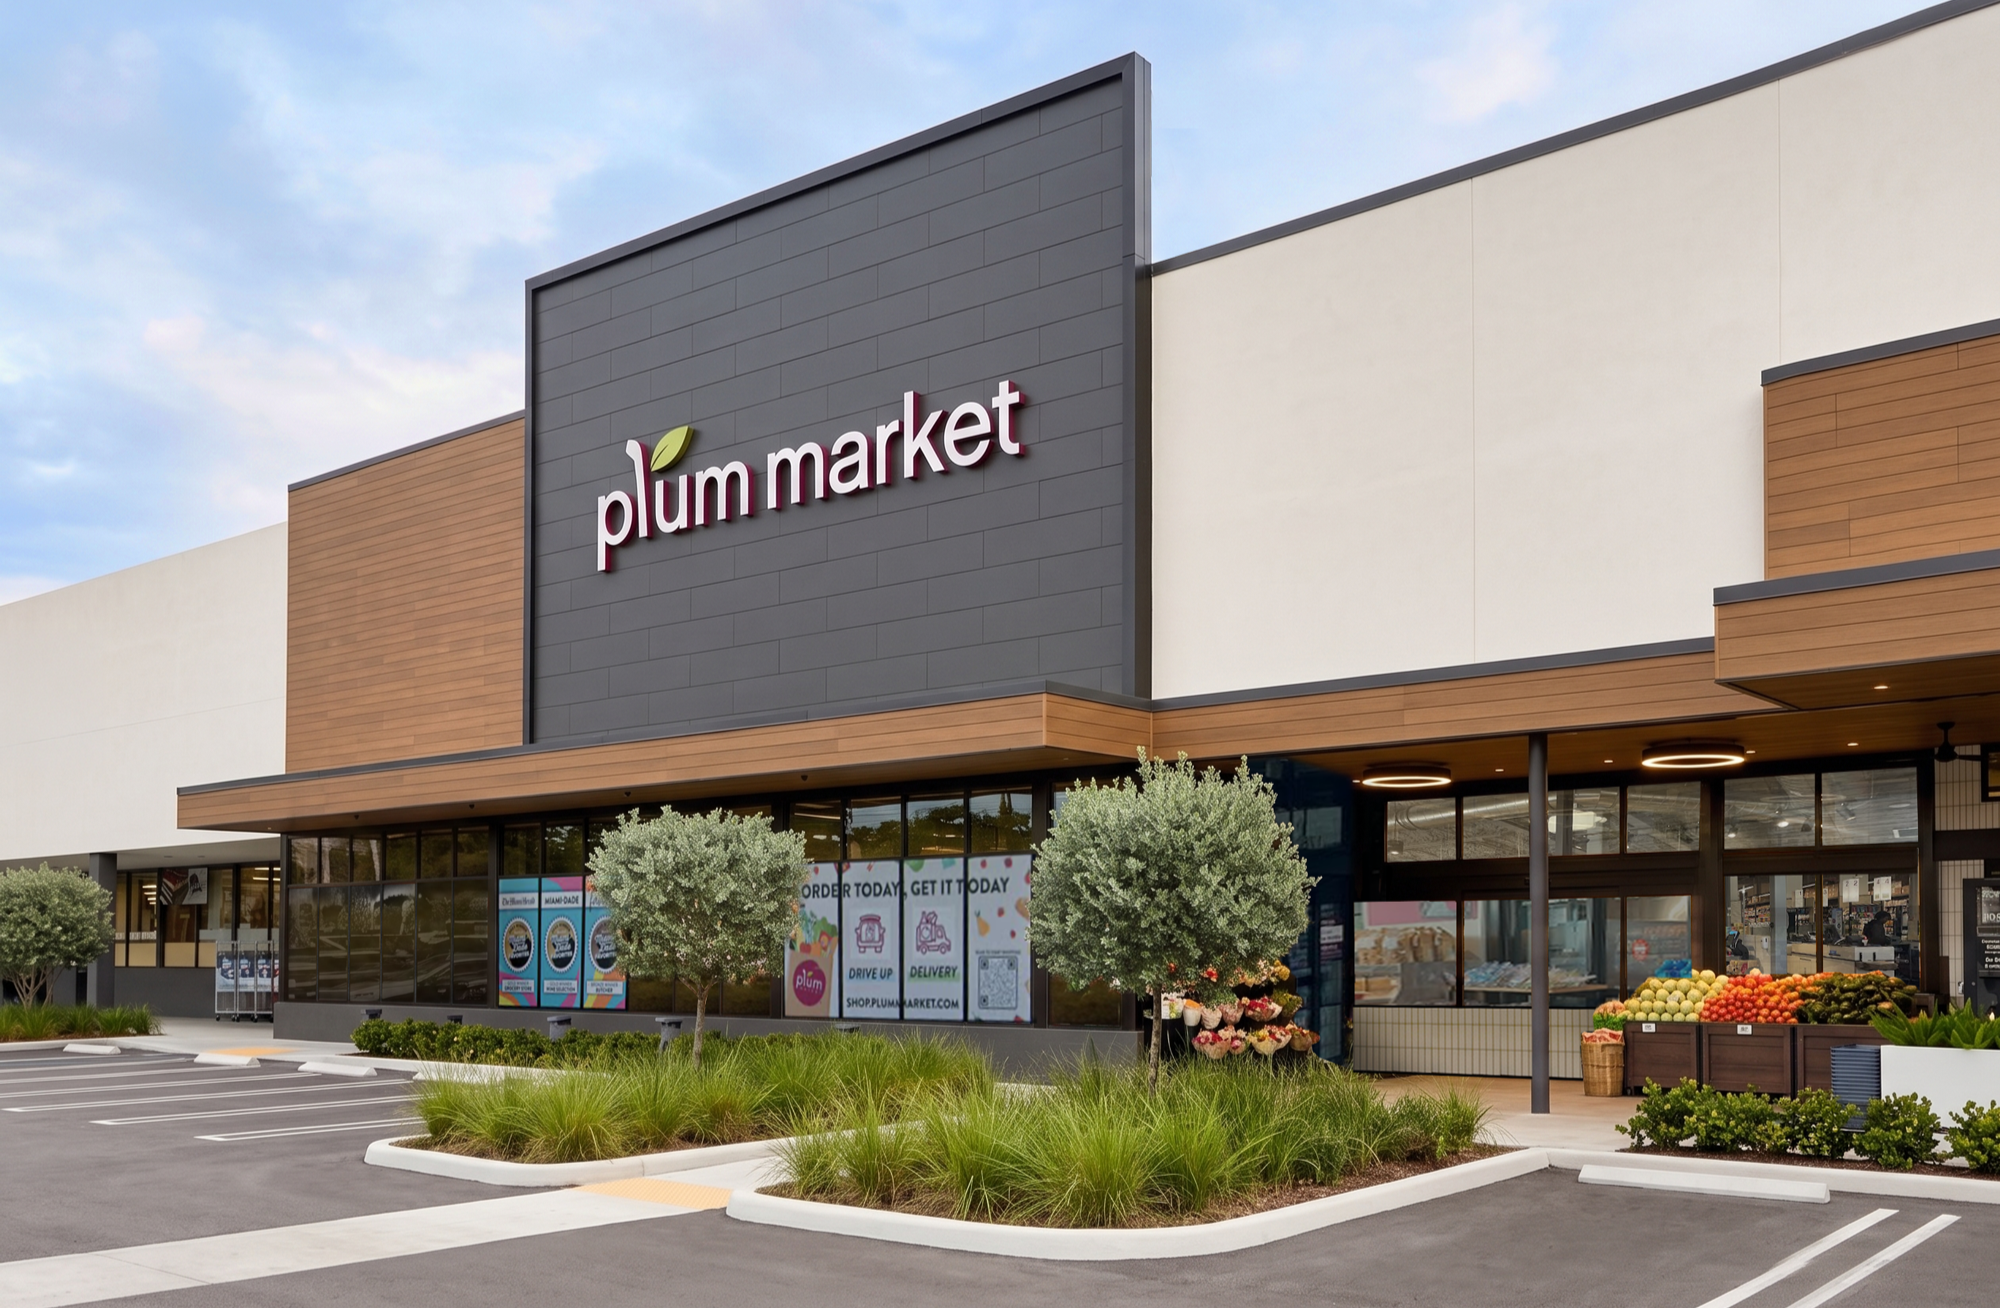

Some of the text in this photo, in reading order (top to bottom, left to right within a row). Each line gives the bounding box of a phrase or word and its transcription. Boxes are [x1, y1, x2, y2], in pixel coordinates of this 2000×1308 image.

[597, 379, 1026, 573] plum market
[801, 883, 851, 899] ORDER
[910, 880, 937, 896] GET
[941, 879, 953, 895] IT
[956, 877, 1010, 895] TODAY
[796, 969, 823, 990] plum
[849, 968, 893, 980] DRIVE UP
[910, 966, 958, 978] DELIVERY
